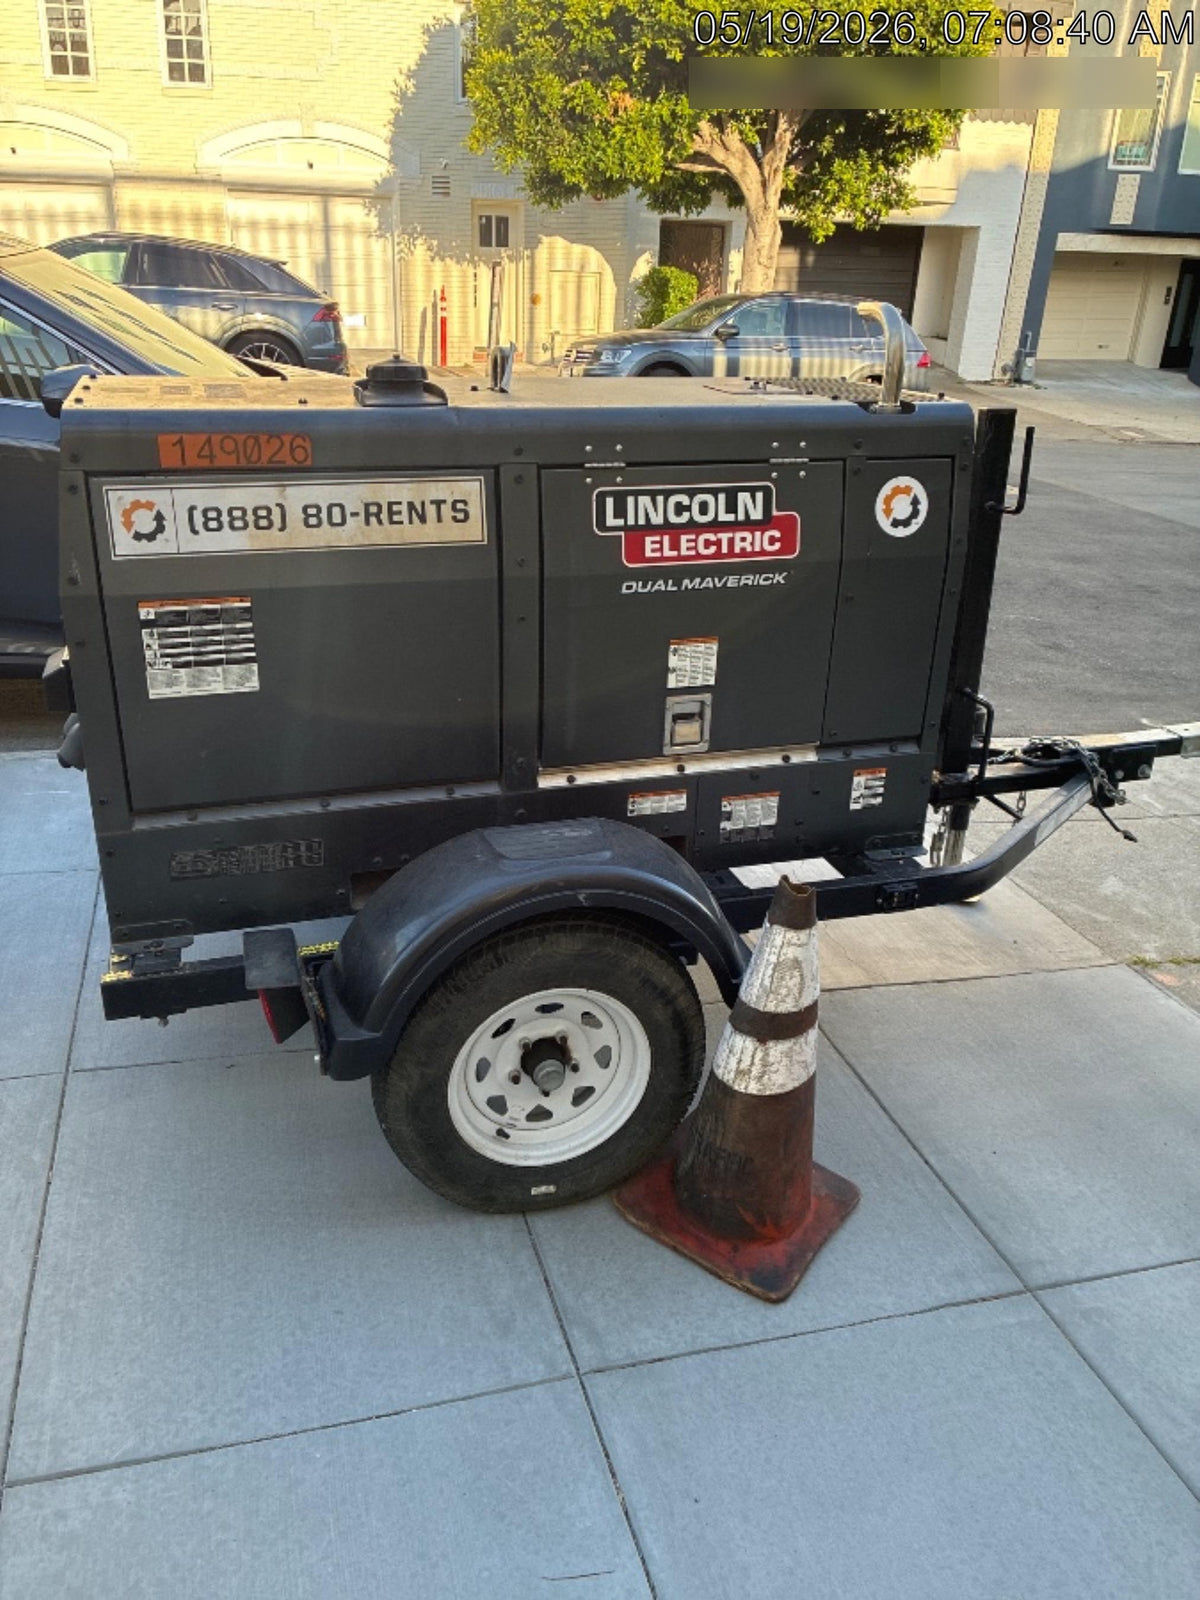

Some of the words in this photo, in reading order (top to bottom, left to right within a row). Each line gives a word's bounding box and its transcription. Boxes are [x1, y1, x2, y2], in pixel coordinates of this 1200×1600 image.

[172, 435, 310, 464] 149026
[188, 504, 286, 534] (888)
[303, 498, 471, 529] 80-RENTS
[605, 491, 763, 526] LINCOLN
[644, 531, 782, 557] ELECTRIC
[621, 579, 678, 594] DUAL
[681, 572, 787, 591] MAVERICK
